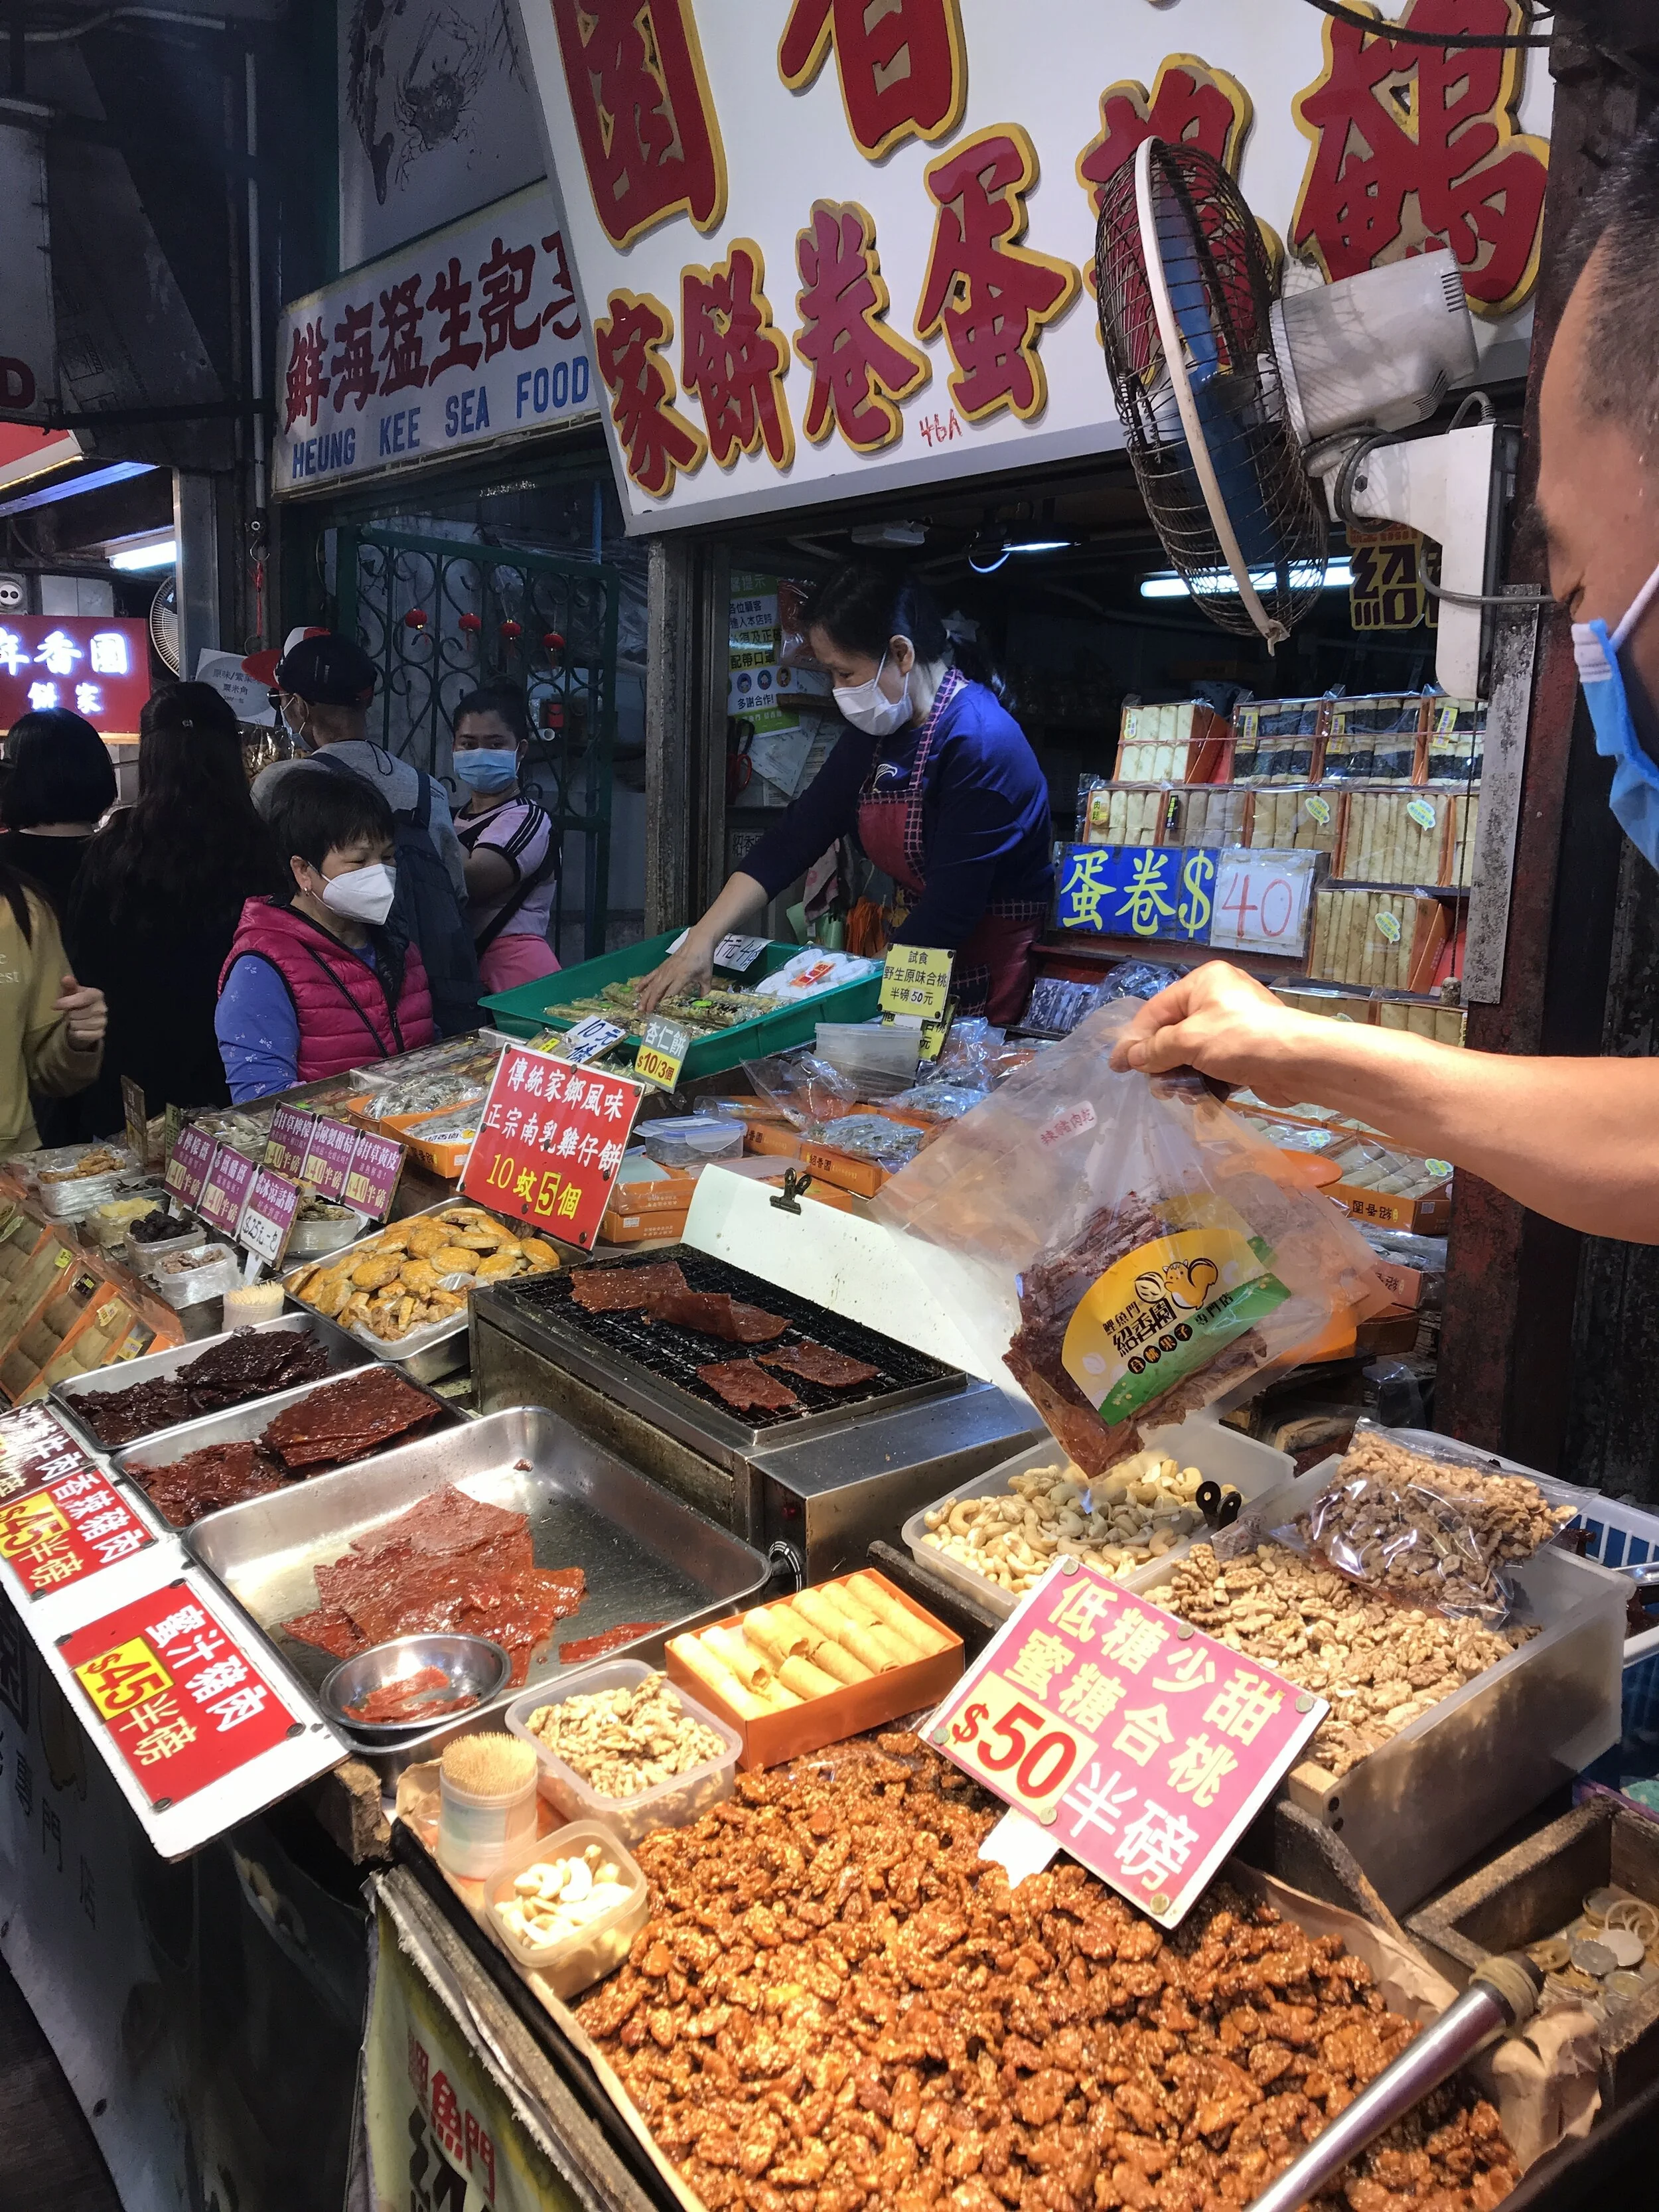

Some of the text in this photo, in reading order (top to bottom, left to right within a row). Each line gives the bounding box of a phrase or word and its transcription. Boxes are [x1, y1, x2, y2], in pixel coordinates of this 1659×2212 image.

[292, 355, 589, 479] HEUNG KEE SEA FOOD
[1060, 849, 1177, 935] 蛋卷
[883, 965, 948, 989] 野生原味合桃
[908, 950, 929, 965] 試食
[890, 986, 934, 1006] 半磅50元
[637, 1052, 675, 1082] $10/3個
[644, 1021, 686, 1057] 杏仁餅
[507, 1057, 624, 1122] 傳統家鄉風味
[360, 1141, 399, 1171] 甘草黃皮
[485, 1103, 623, 1176] 正宗南乳雞仔餅
[1102, 1301, 1141, 1337] 鯉魚門
[1112, 1297, 1177, 1358] 紹香園
[1127, 1322, 1193, 1375] 合桃果子
[51, 1473, 145, 1564] 香辣豬肉
[18, 1534, 84, 1589] 半磅
[144, 1604, 268, 1732] 蜜汁豬肉
[1047, 1577, 1284, 1747] 低糖少甜
[86, 1651, 198, 1766] $45 半磅
[1003, 1628, 1239, 1808] 蜜糖合桃
[951, 1700, 1200, 1892] $50 半磅
